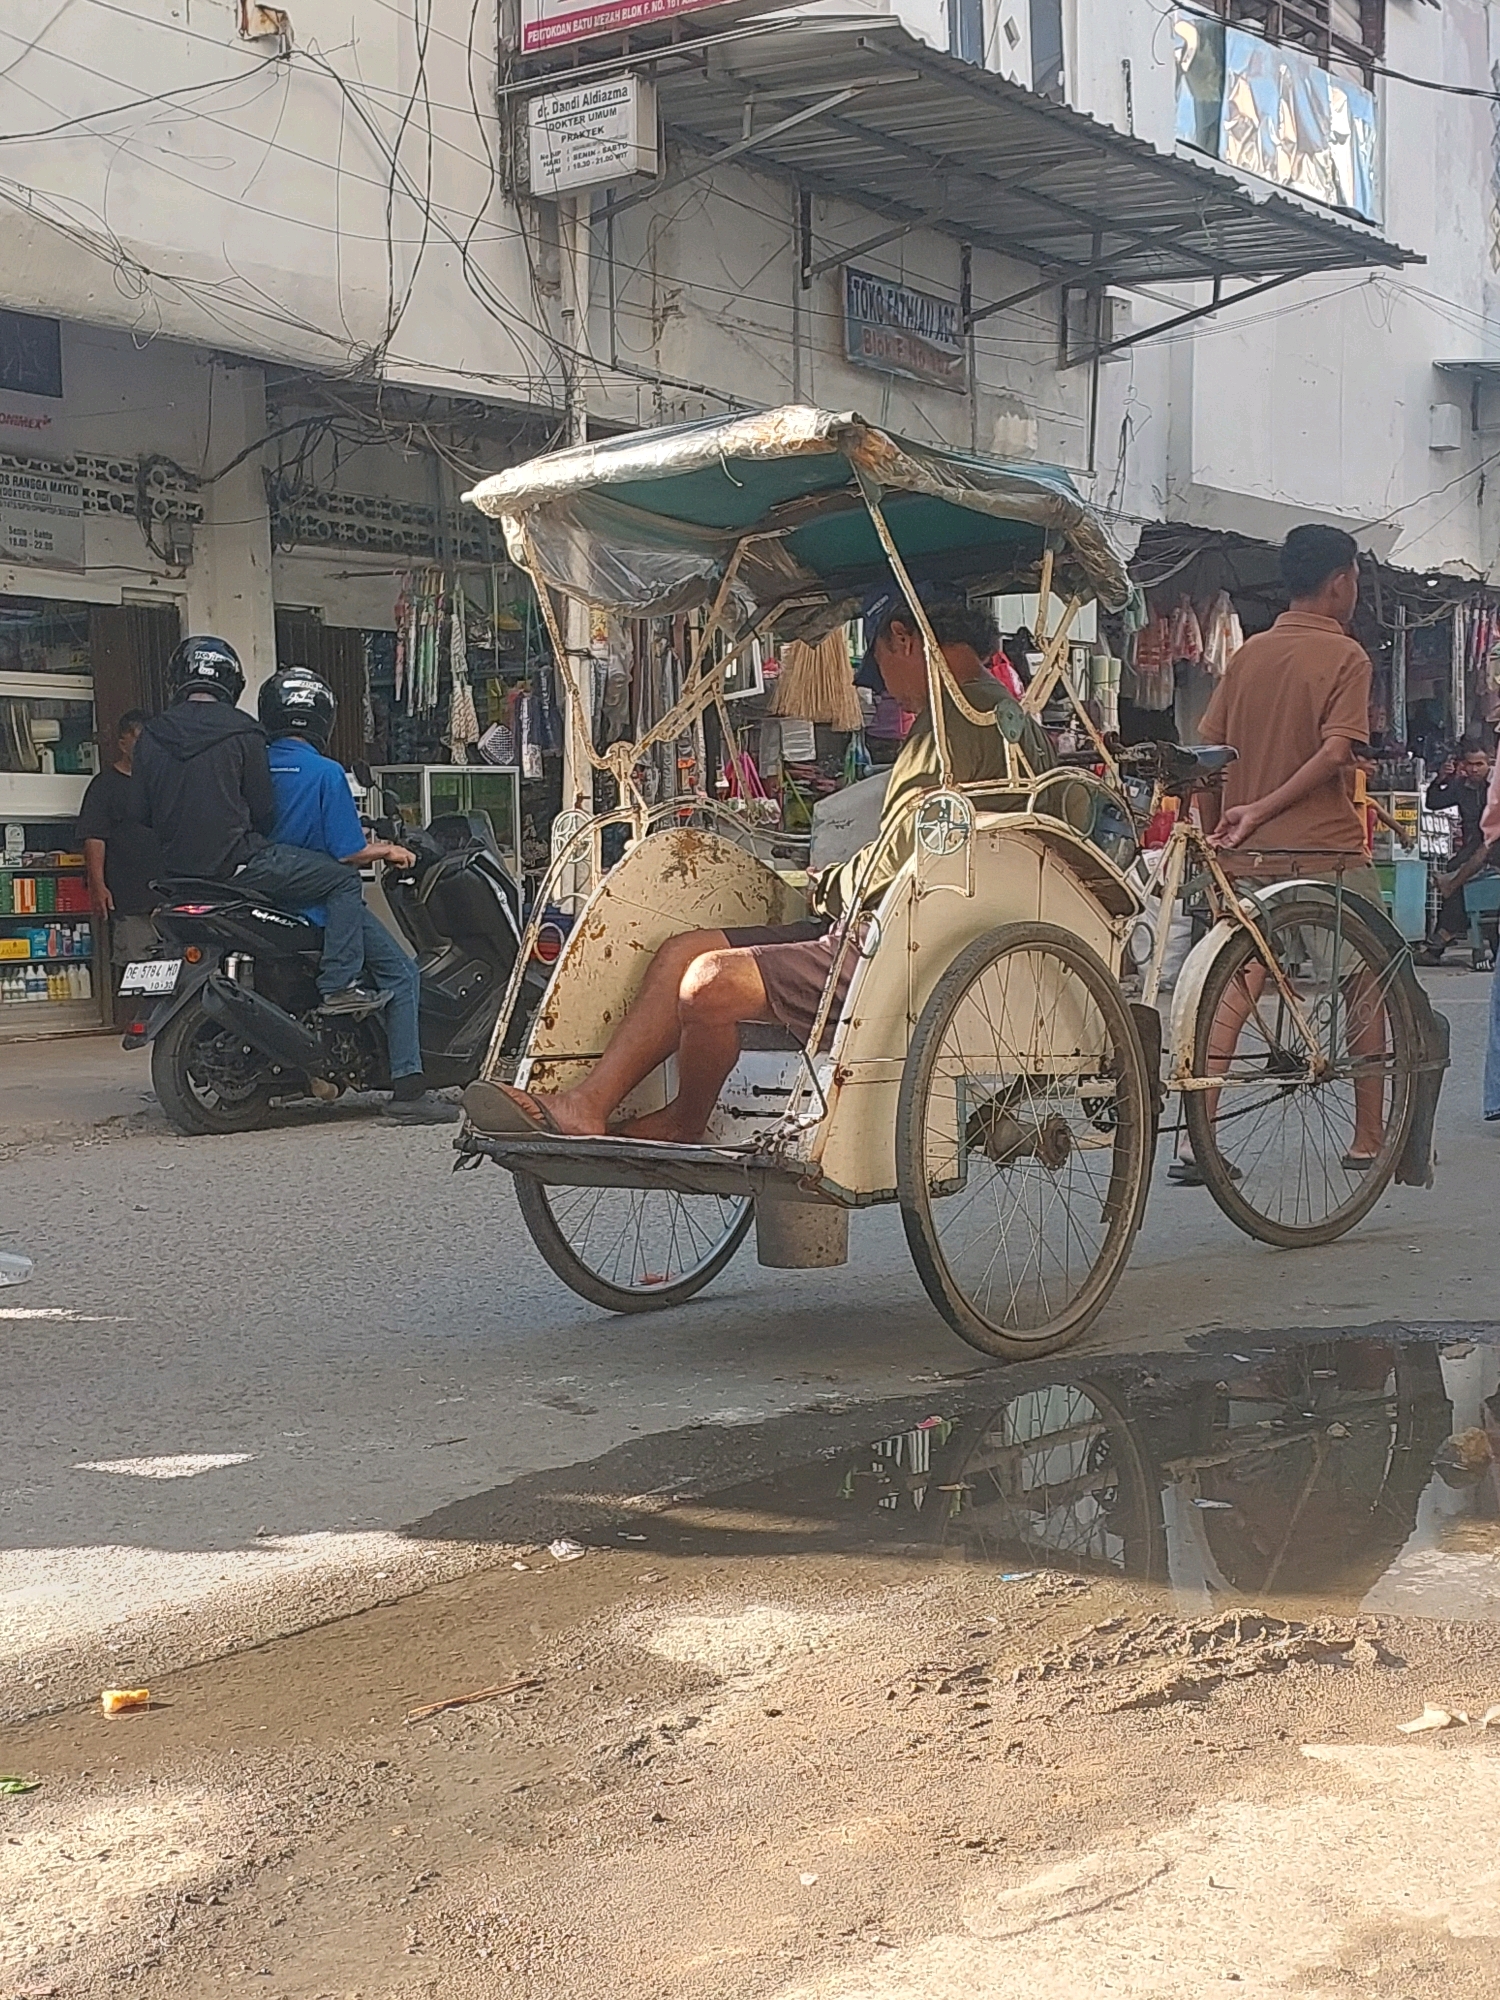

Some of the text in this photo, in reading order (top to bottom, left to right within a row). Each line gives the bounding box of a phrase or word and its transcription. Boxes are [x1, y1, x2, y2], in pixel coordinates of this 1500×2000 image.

[573, 15, 593, 32] BATU
[594, 9, 621, 27] MERAH
[621, 4, 643, 20] BLOK
[651, 1, 665, 13] NO.
[537, 86, 628, 118] dr. Dandi Aldiazma
[549, 107, 617, 131] DOKTER UMUM
[561, 125, 605, 144] PRAKTEK
[573, 149, 597, 161] SENIN
[602, 141, 629, 154] SABTU
[851, 275, 884, 325] TOKO
[12, 475, 48, 492] RANGGA
[50, 481, 79, 496] MAYKO
